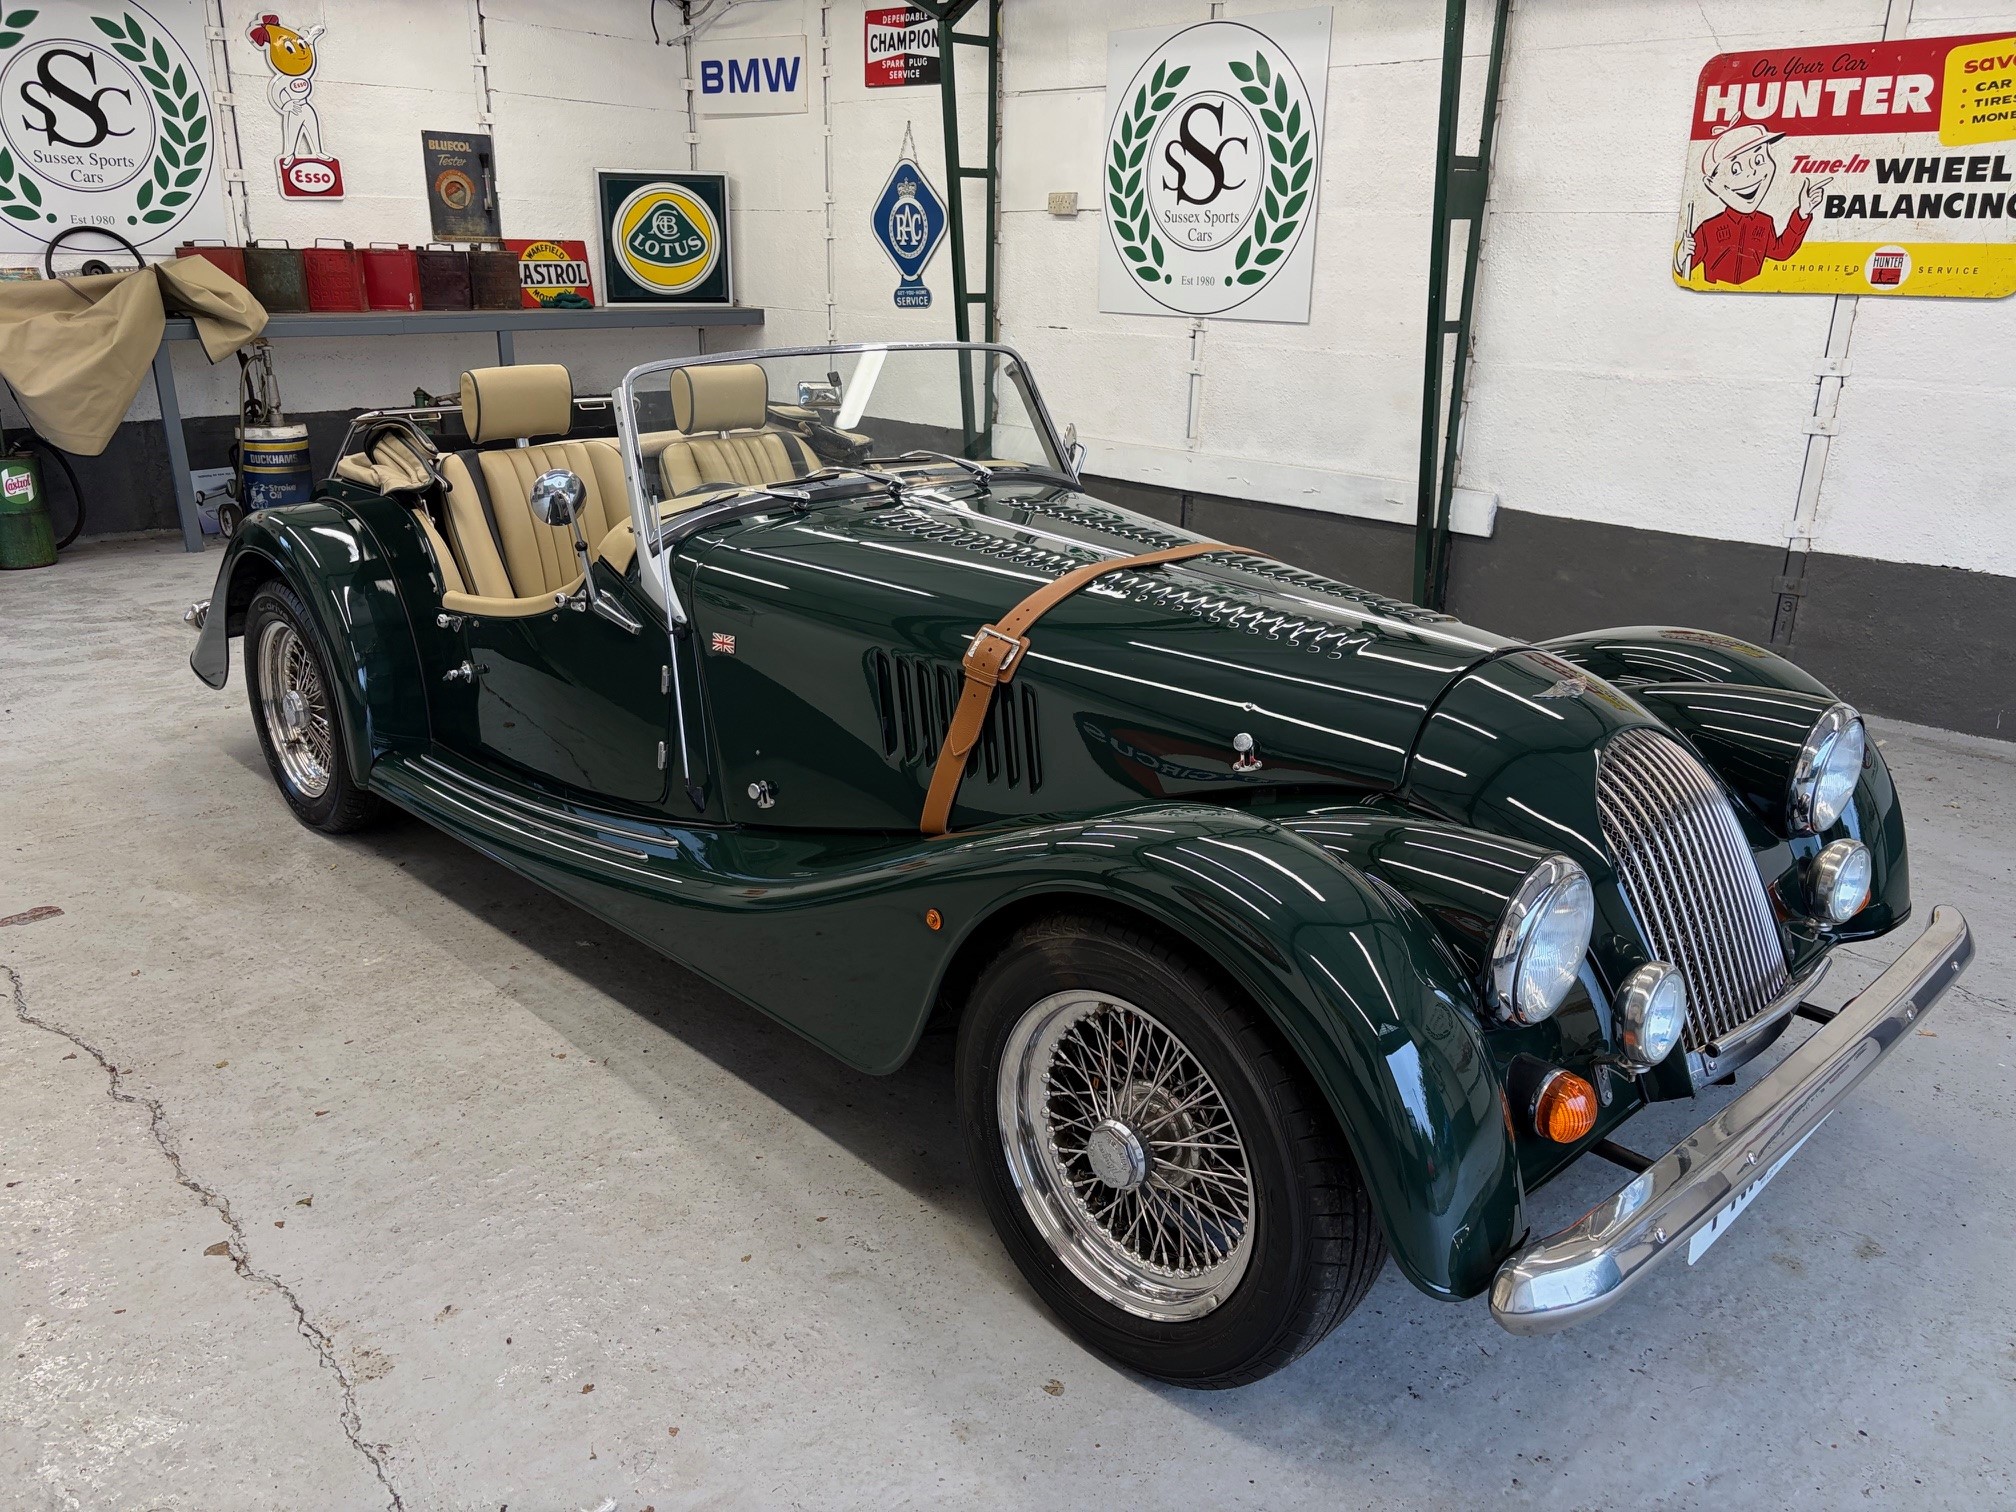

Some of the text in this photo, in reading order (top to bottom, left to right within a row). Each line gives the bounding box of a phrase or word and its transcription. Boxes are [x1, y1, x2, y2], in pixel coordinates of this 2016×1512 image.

[882, 12, 928, 24] DEPENDABLE
[870, 28, 939, 53] CHAMPION
[882, 58, 928, 69] SPARK PLUG
[1752, 53, 1870, 81] On Your Car
[701, 56, 800, 94] BMW
[889, 69, 920, 79] SERVICE
[1975, 79, 2012, 92] CAR
[1703, 73, 1935, 122] HUNTER
[428, 139, 472, 152] BLUECOL
[33, 149, 135, 172] Sussex Sports
[437, 154, 467, 166] Tester
[1790, 154, 2012, 184] Tune-In WHEEL
[70, 169, 104, 184] Cars
[295, 170, 331, 183] Esso
[70, 214, 116, 226] Est 1980
[1164, 209, 1240, 227] Sussex Sports
[896, 205, 922, 245] RAC
[1187, 228, 1213, 242] Cars
[633, 232, 702, 258] LOTUS
[526, 244, 565, 260] WAKEFIELD
[1773, 264, 1860, 273] AUTHORIZED
[1873, 256, 1904, 268] HUNTER
[520, 263, 587, 285] ASTROL
[1918, 266, 1980, 275] SERVICE
[1181, 276, 1215, 287] Est 1980
[897, 296, 928, 306] SERVICE
[250, 453, 299, 465] DUCKHAMS
[5, 474, 31, 495] Castrol
[260, 483, 297, 493] 2-Stroke
[269, 491, 282, 499] Oil
